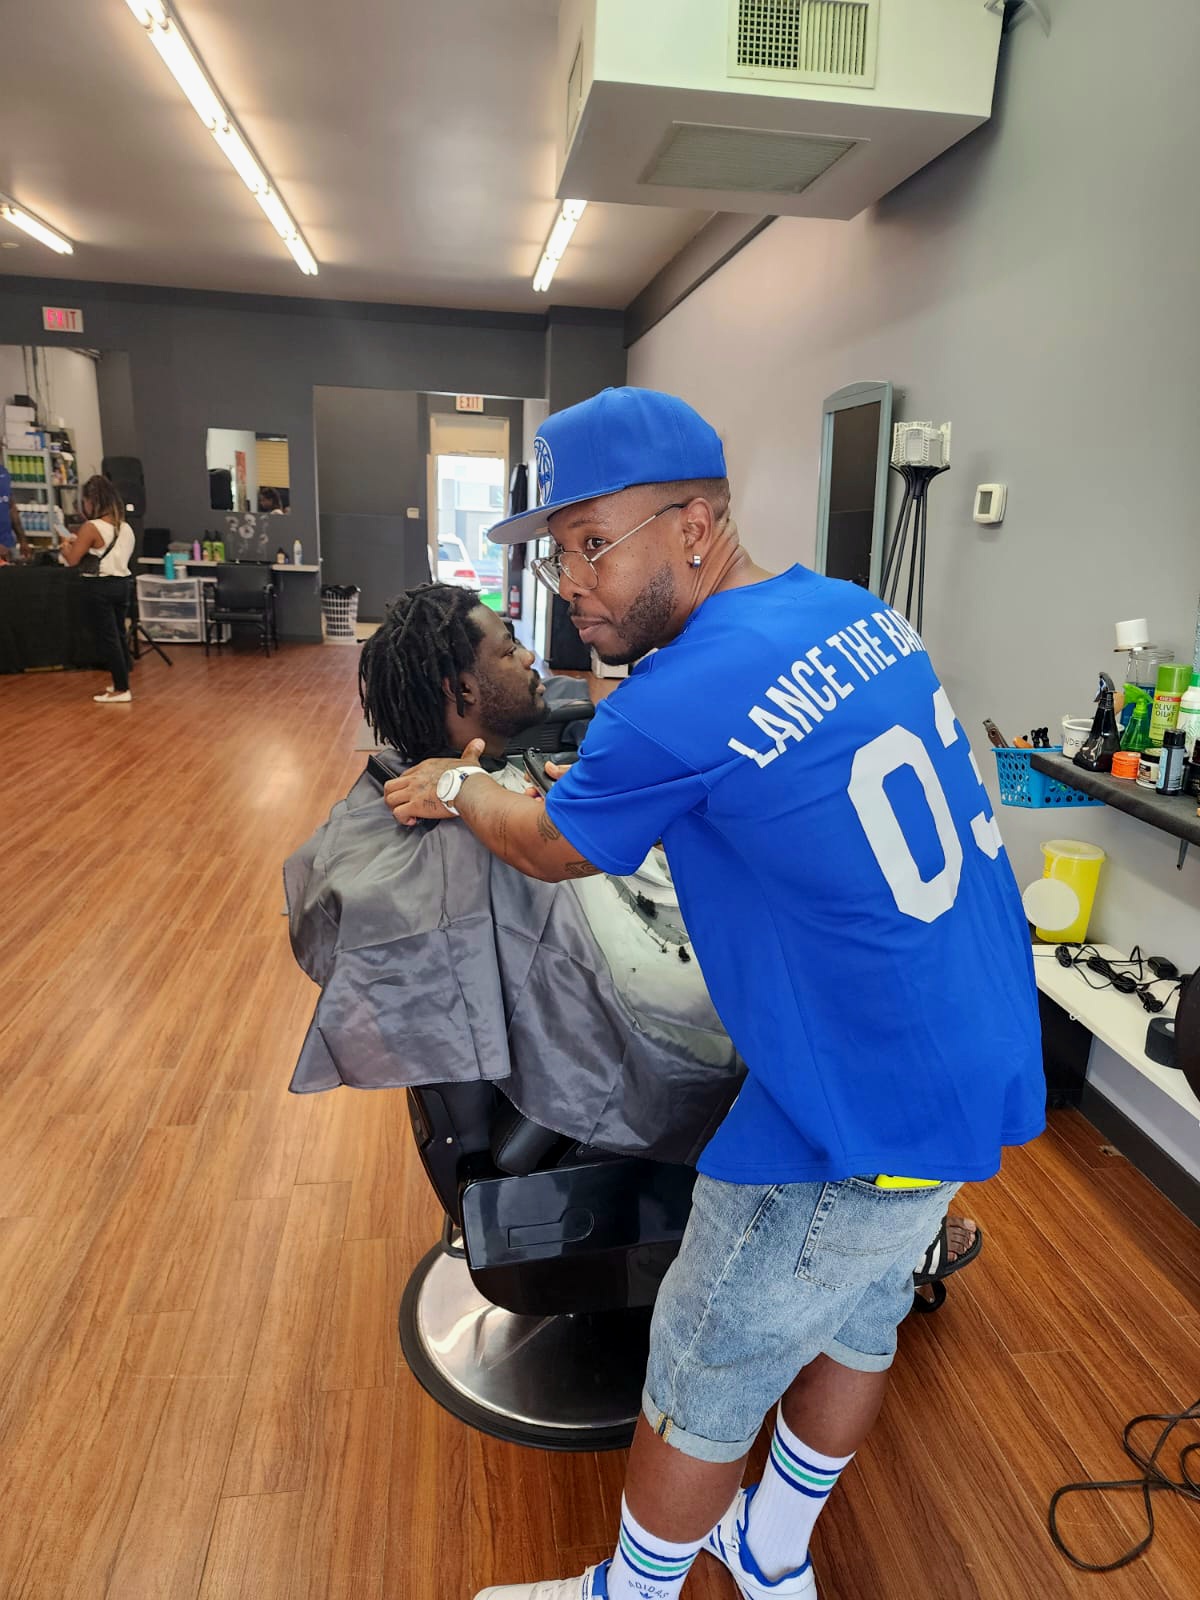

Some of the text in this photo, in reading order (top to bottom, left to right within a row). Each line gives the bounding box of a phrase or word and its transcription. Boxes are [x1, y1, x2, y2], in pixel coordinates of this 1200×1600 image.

[46, 308, 77, 330] EXIT
[459, 395, 480, 409] EXIT
[728, 645, 855, 768] LANCE
[825, 618, 897, 682] THE
[1154, 703, 1177, 712] OLIVE
